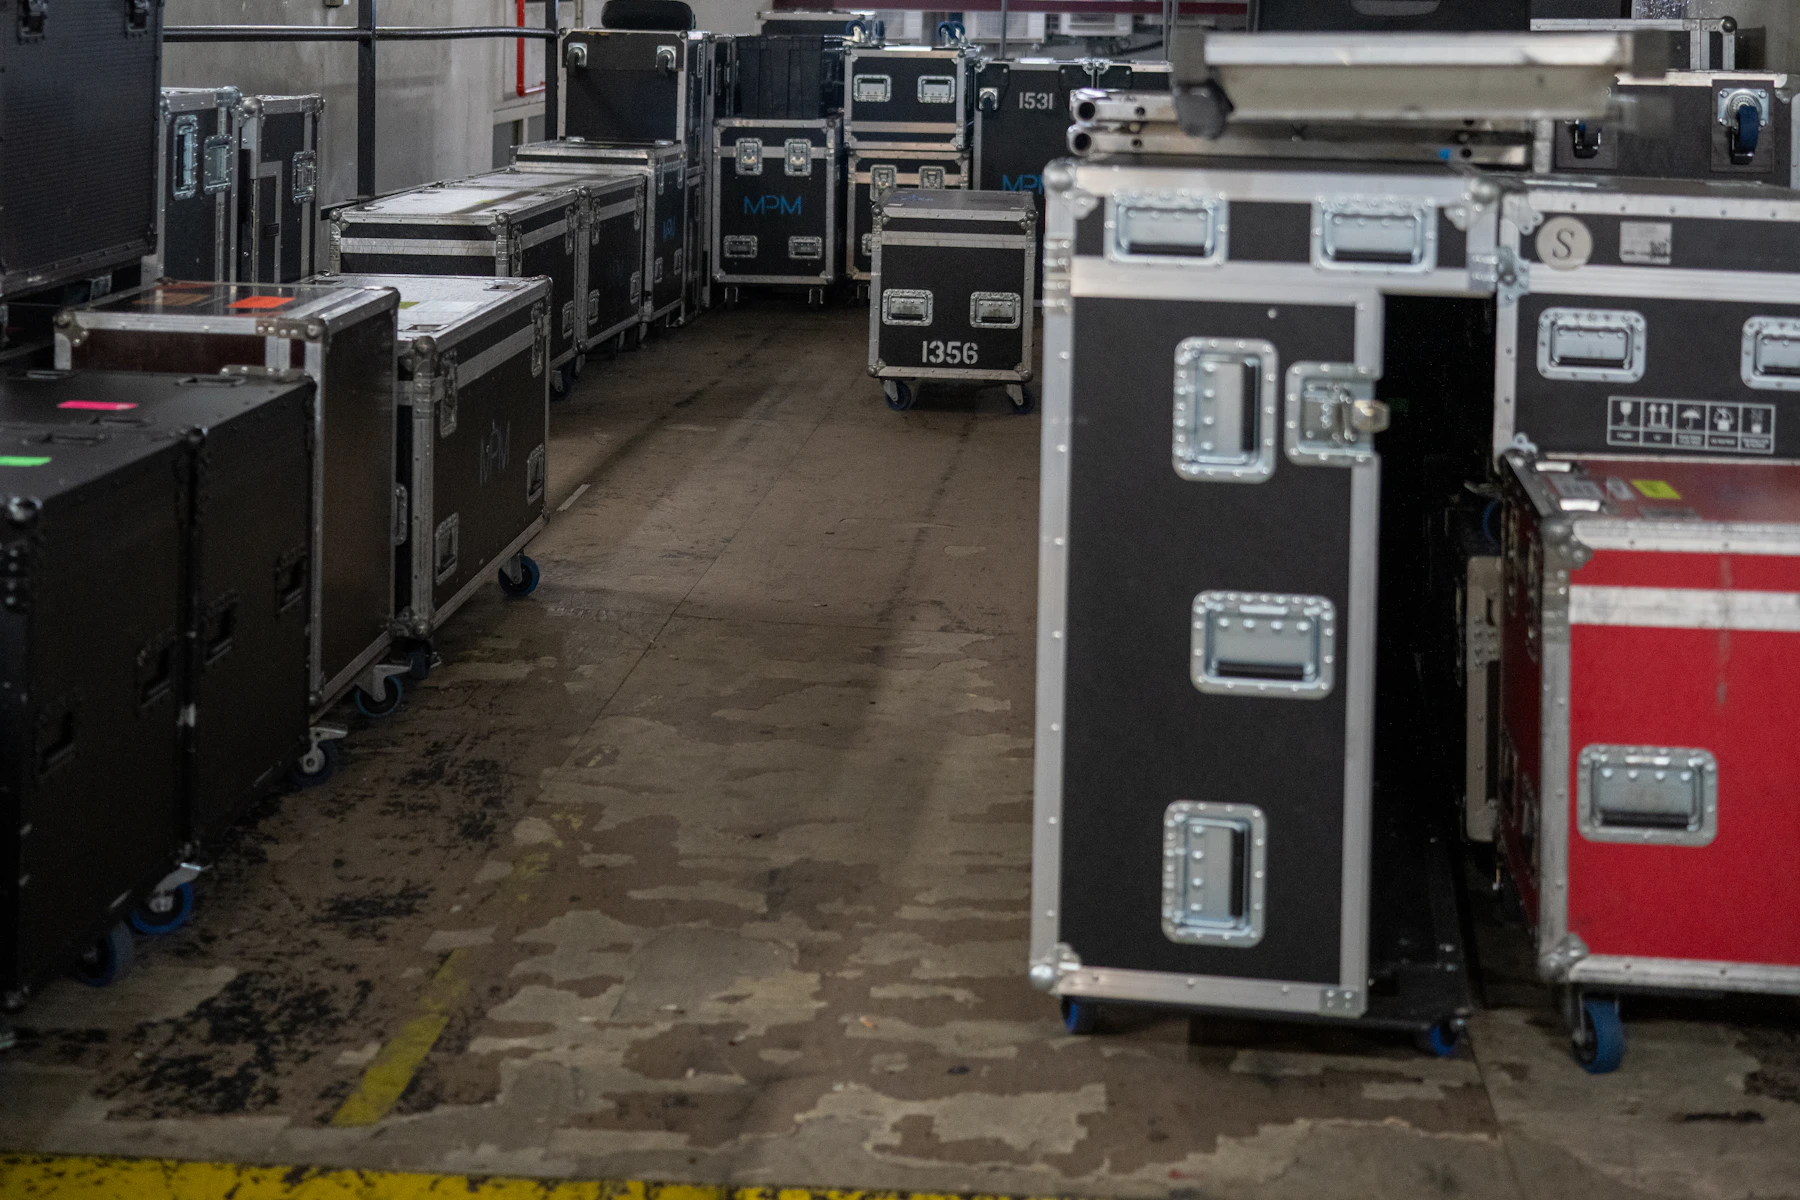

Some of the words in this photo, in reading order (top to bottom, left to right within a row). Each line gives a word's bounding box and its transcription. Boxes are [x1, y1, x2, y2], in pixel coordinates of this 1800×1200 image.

[1019, 92, 1053, 110] 1531
[743, 195, 802, 215] MPM
[1552, 228, 1575, 259] S
[922, 341, 978, 365] 1356
